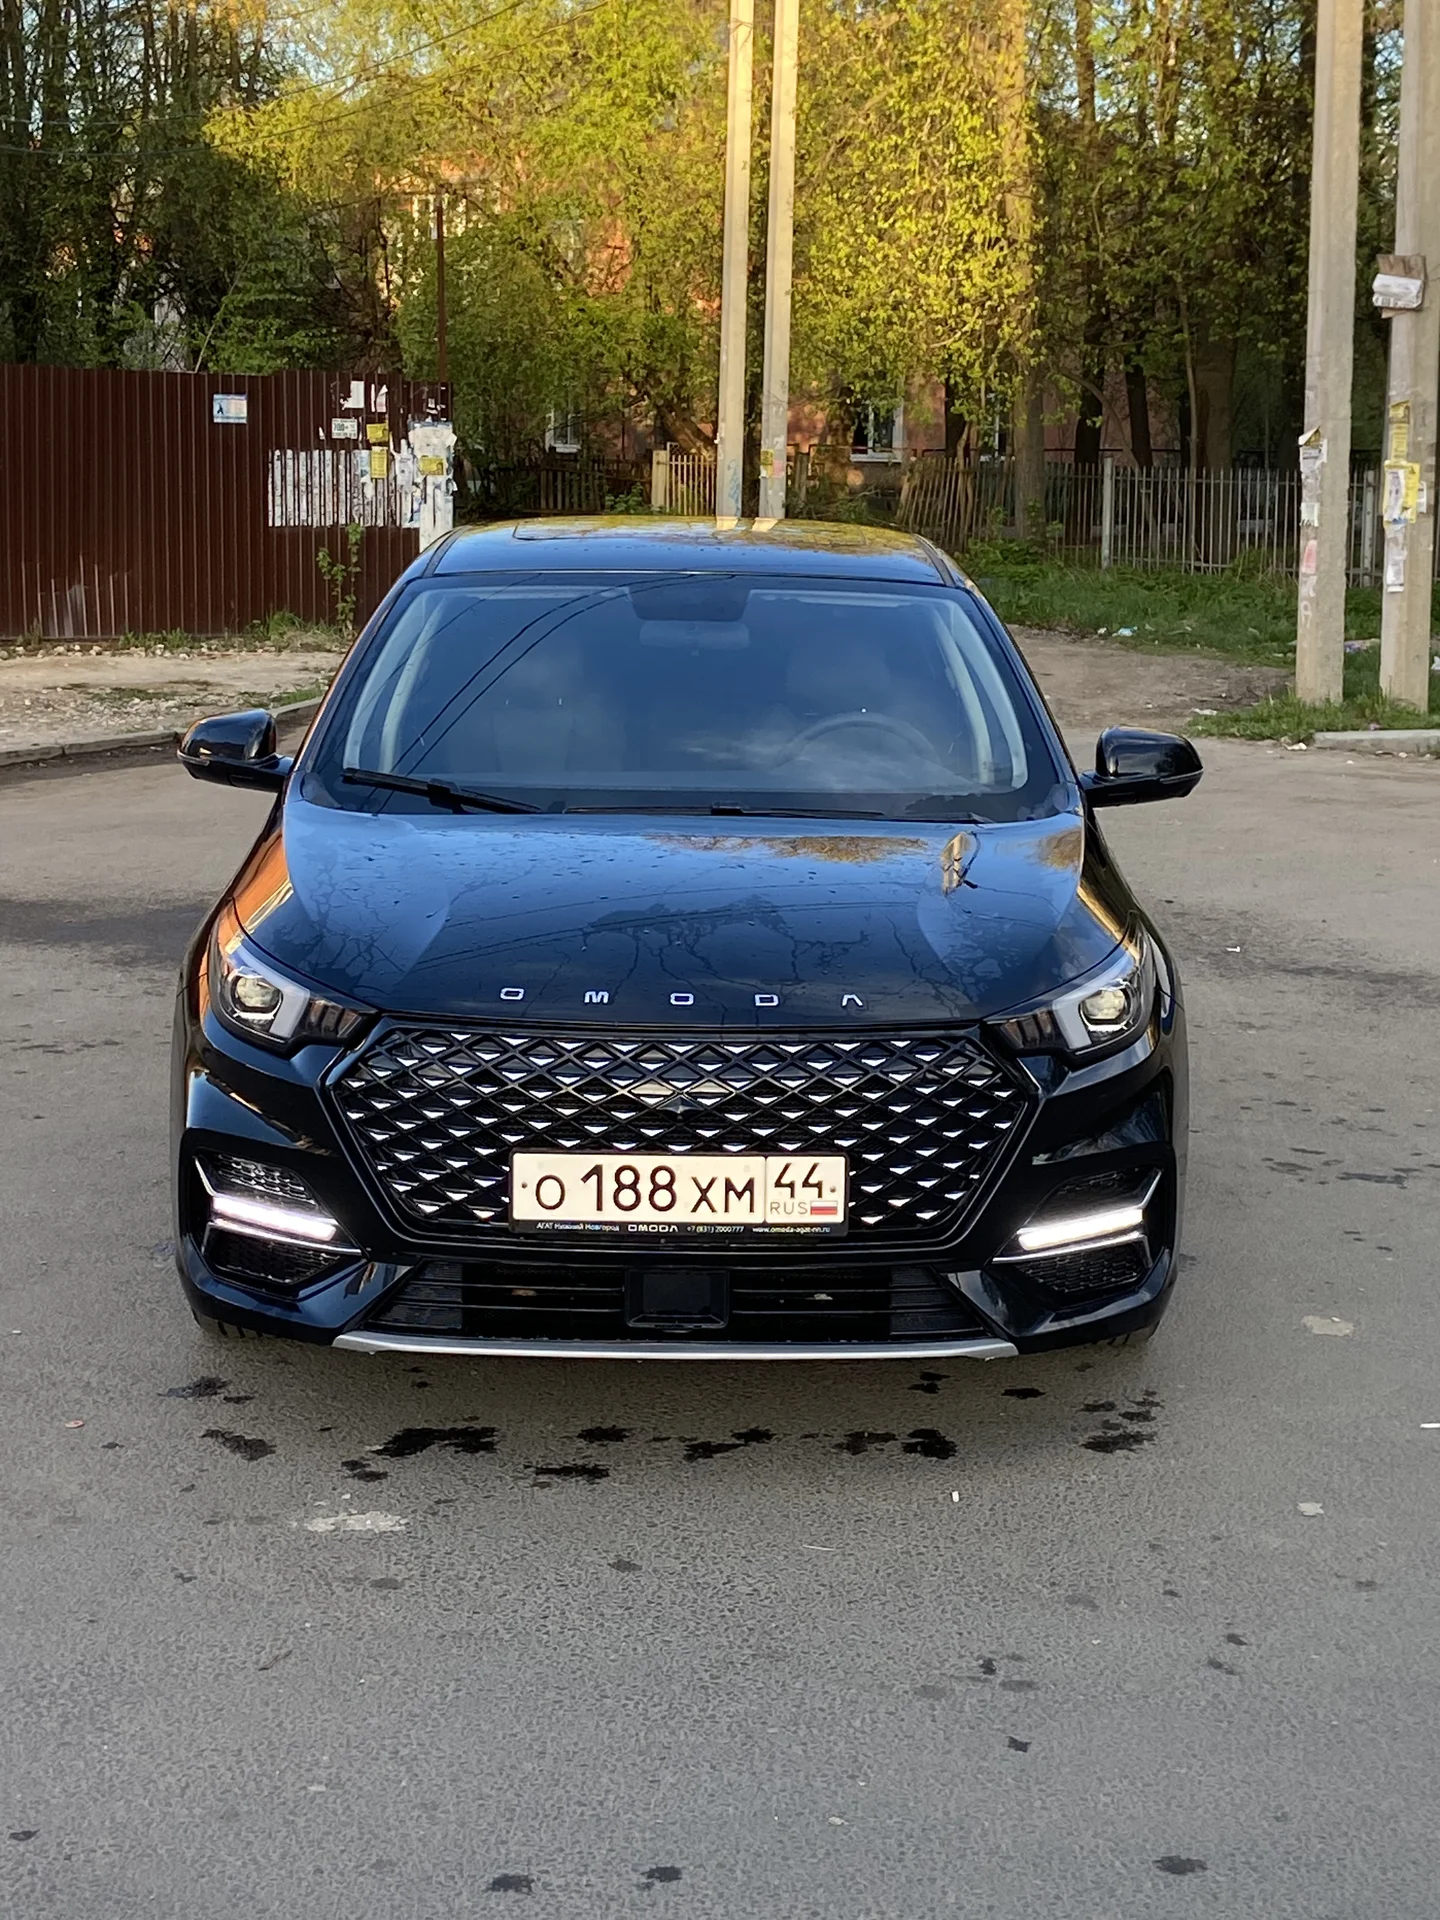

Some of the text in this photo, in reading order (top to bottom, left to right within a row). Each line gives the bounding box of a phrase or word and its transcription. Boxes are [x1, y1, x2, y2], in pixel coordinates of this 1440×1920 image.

[580, 1163, 678, 1213] 188
[690, 1175, 755, 1214] ХМ
[774, 1162, 823, 1199] 44
[770, 1201, 808, 1215] RUS
